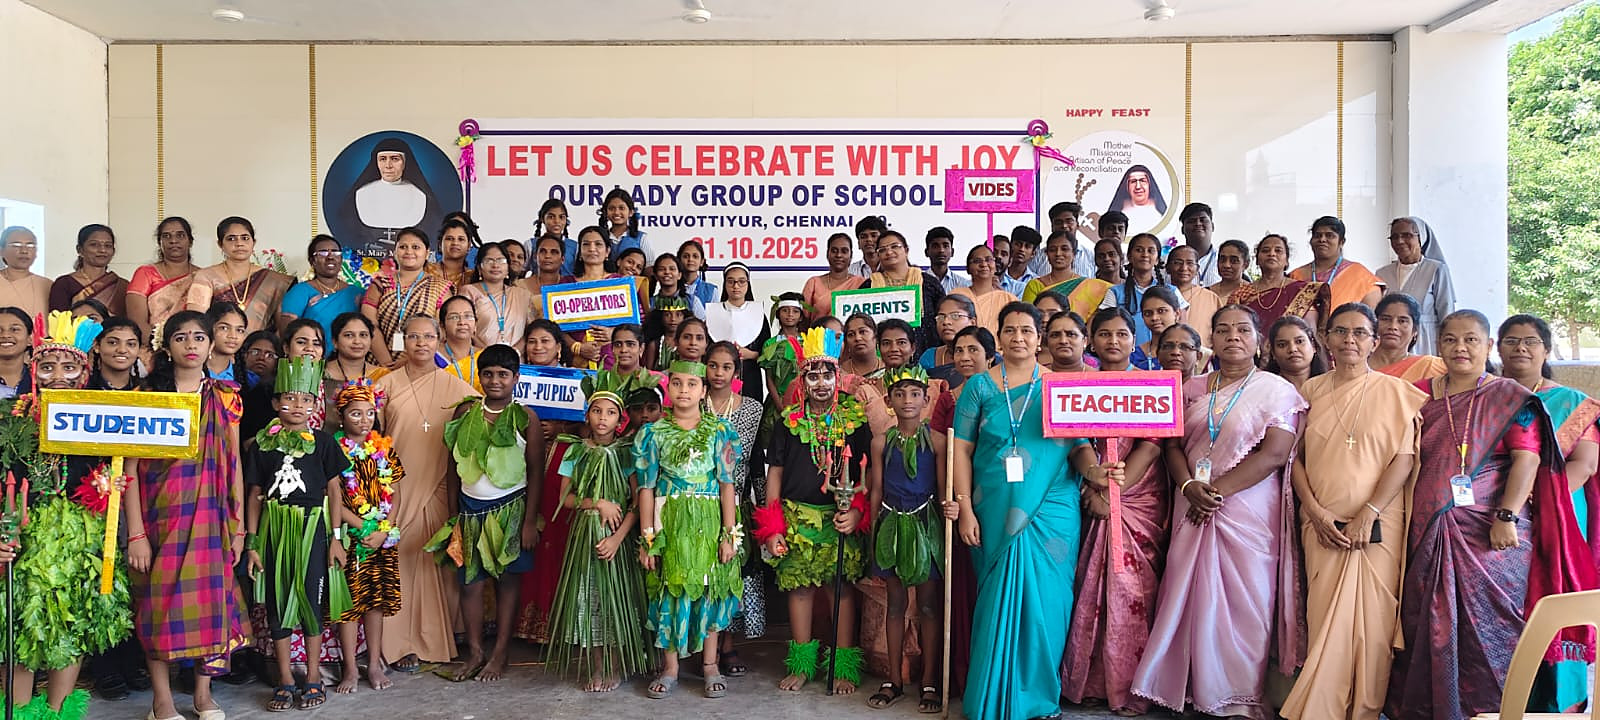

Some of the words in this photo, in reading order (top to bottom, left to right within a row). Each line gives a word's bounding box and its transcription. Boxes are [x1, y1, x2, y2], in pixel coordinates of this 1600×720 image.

[1066, 109, 1103, 117] HAPPY
[1112, 109, 1151, 117] FEAST
[1090, 148, 1132, 157] Missionary
[1103, 141, 1132, 149] Mother
[487, 145, 552, 176] LET
[566, 145, 612, 176] US
[626, 145, 834, 176] CELEBRATE
[847, 145, 938, 176] WITH
[952, 145, 1020, 170] JOY
[1097, 156, 1105, 164] of
[1107, 157, 1132, 165] Peace
[550, 185, 604, 206] OUR
[615, 185, 682, 206] ADY
[691, 185, 782, 206] GROUP
[792, 185, 825, 206] OF
[834, 185, 942, 206] SCHOOL
[968, 182, 1015, 197] VIDES
[628, 215, 767, 229] IRUVOTTIYUR,
[774, 215, 852, 227] CHENNAI
[368, 249, 386, 257] Mary
[554, 293, 626, 315] CO-OPERATORS
[843, 301, 910, 316] PARENTS
[512, 381, 531, 399] AST
[1057, 394, 1170, 413] TEACHERS
[53, 412, 186, 436] STUDENTS
